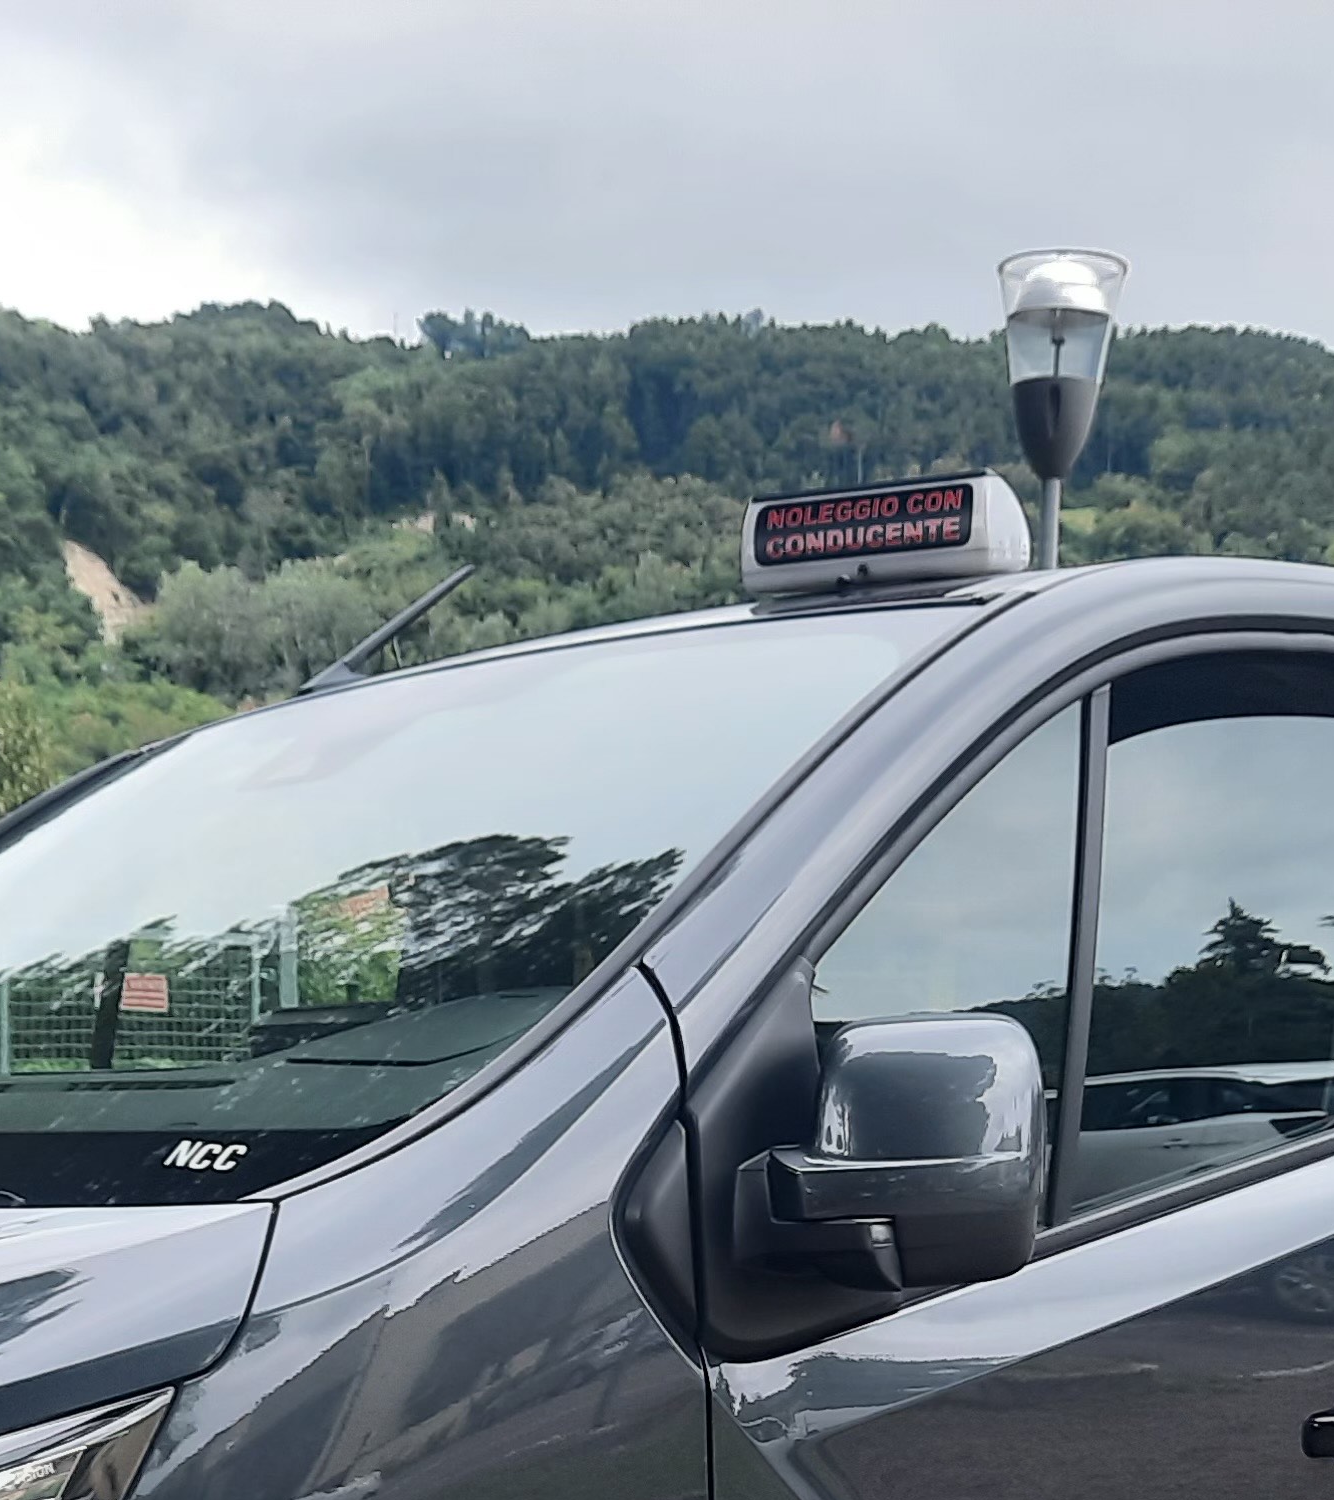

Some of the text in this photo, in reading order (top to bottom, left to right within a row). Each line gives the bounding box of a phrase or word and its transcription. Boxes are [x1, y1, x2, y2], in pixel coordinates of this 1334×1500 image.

[767, 488, 964, 529] NOLEGGIO CON
[766, 515, 962, 559] CONDUCENTE
[163, 1139, 248, 1171] NCC
